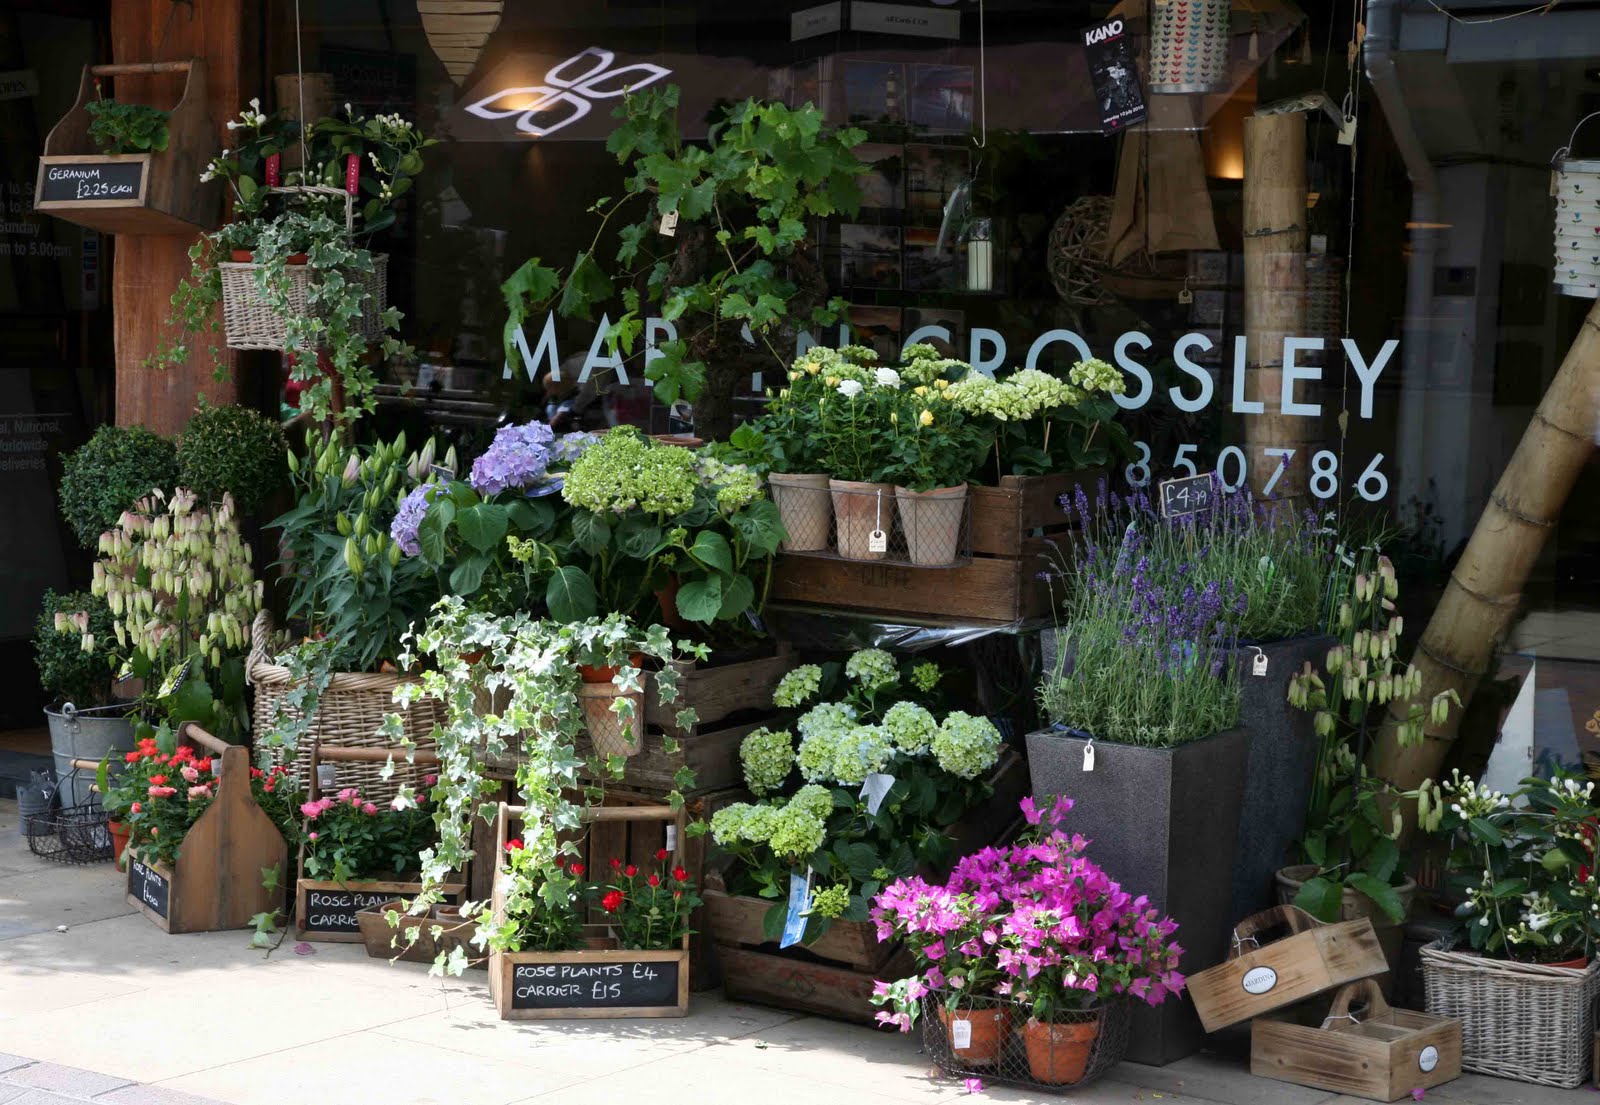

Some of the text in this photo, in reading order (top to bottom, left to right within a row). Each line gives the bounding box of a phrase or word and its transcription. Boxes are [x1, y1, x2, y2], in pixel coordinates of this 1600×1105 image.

[1085, 20, 1123, 47] KANO
[48, 167, 100, 181] GERANIUM
[76, 180, 109, 199] £2.25
[310, 892, 392, 909] ROSE PLAN
[309, 914, 359, 927] CARRIE
[516, 962, 658, 981] ROSE PLANTS £4
[516, 980, 621, 1000] CARRIER £15
